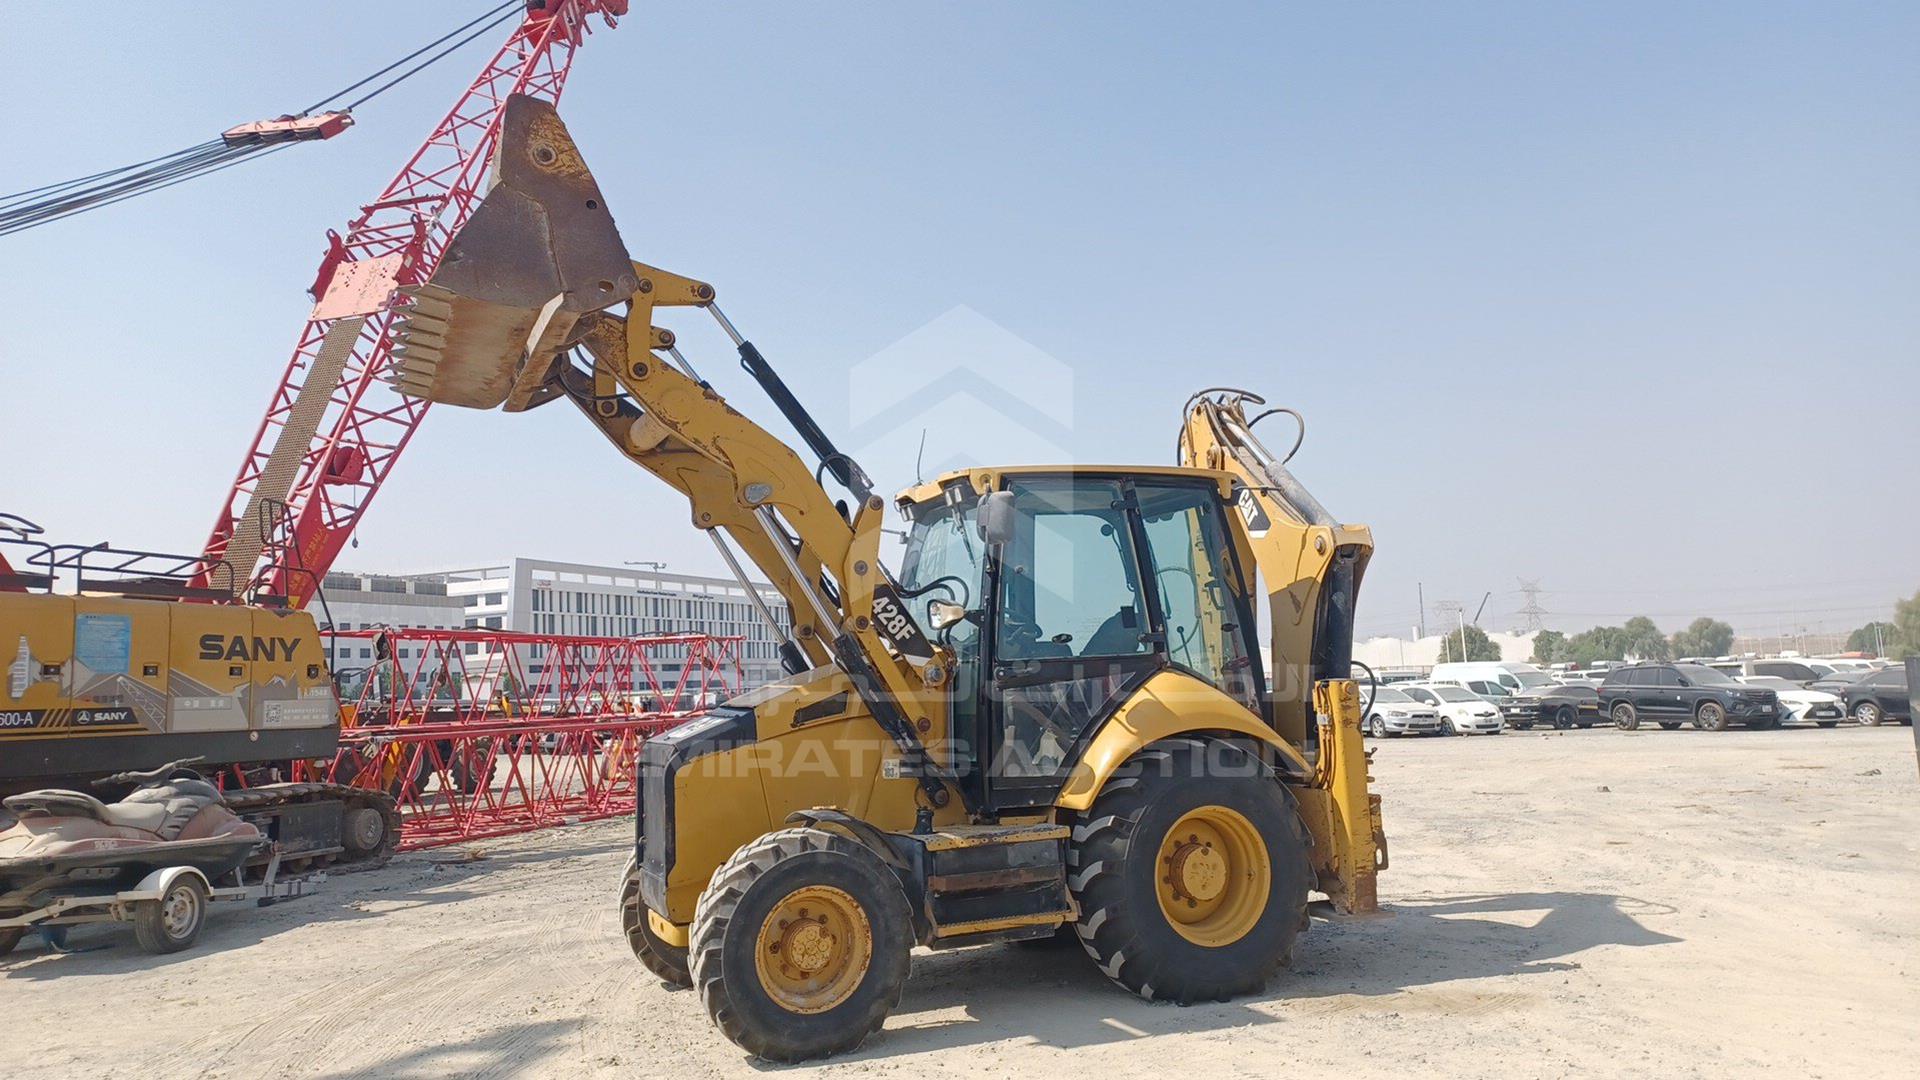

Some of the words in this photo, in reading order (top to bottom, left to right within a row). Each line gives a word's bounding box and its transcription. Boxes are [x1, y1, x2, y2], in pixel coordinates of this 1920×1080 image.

[1238, 489, 1259, 527] CAT
[872, 597, 916, 641] 428F
[199, 634, 301, 662] SANY
[94, 711, 127, 721] SANY
